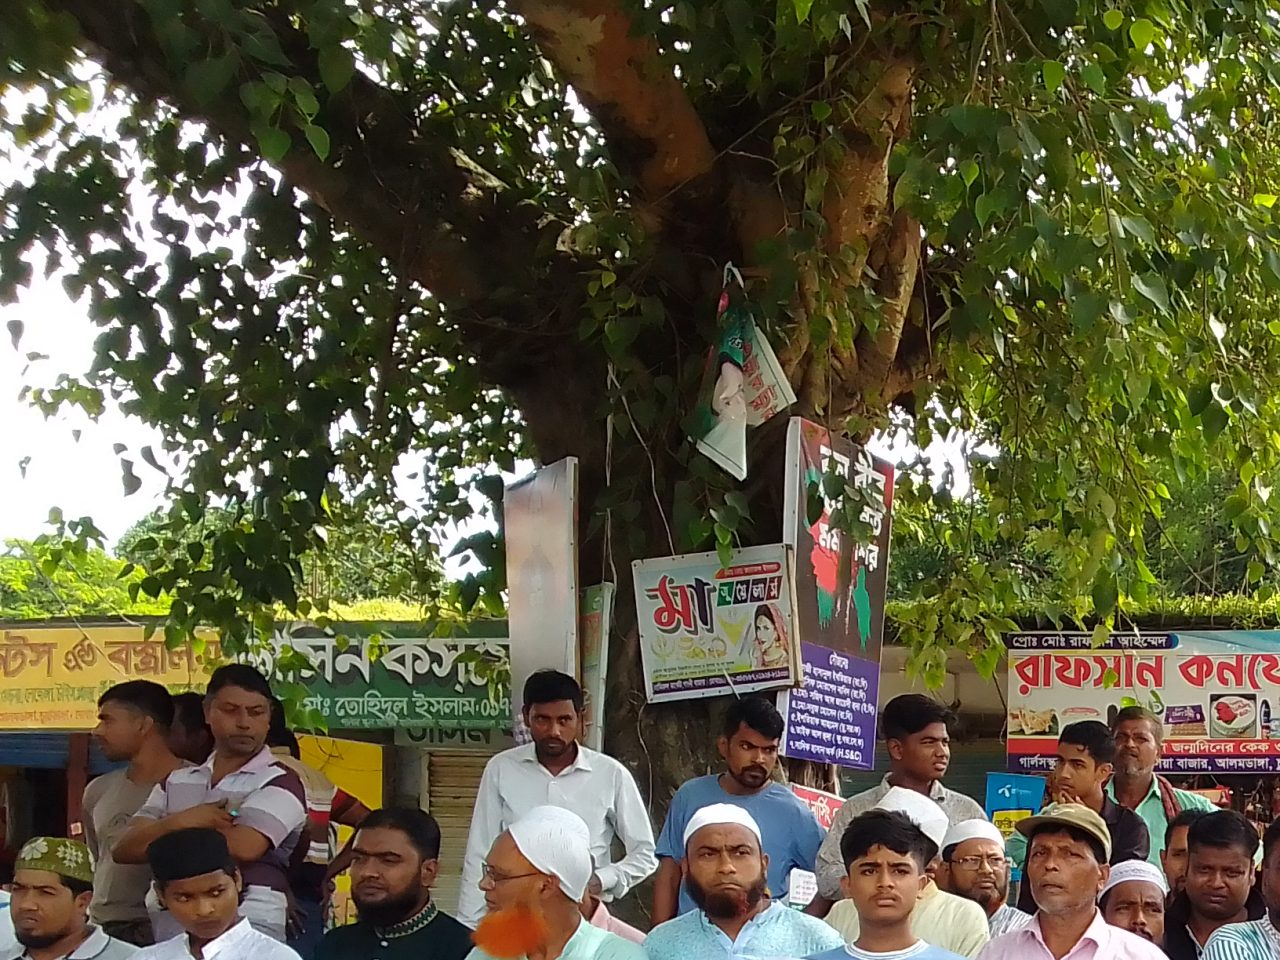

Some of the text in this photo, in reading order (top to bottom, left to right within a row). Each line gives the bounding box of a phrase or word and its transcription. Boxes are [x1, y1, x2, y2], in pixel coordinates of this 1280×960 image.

[645, 574, 717, 635] মা
[1011, 654, 1167, 695] রাফসান
[1171, 740, 1234, 754] জন্মদিনের
[1239, 740, 1269, 753] কেক
